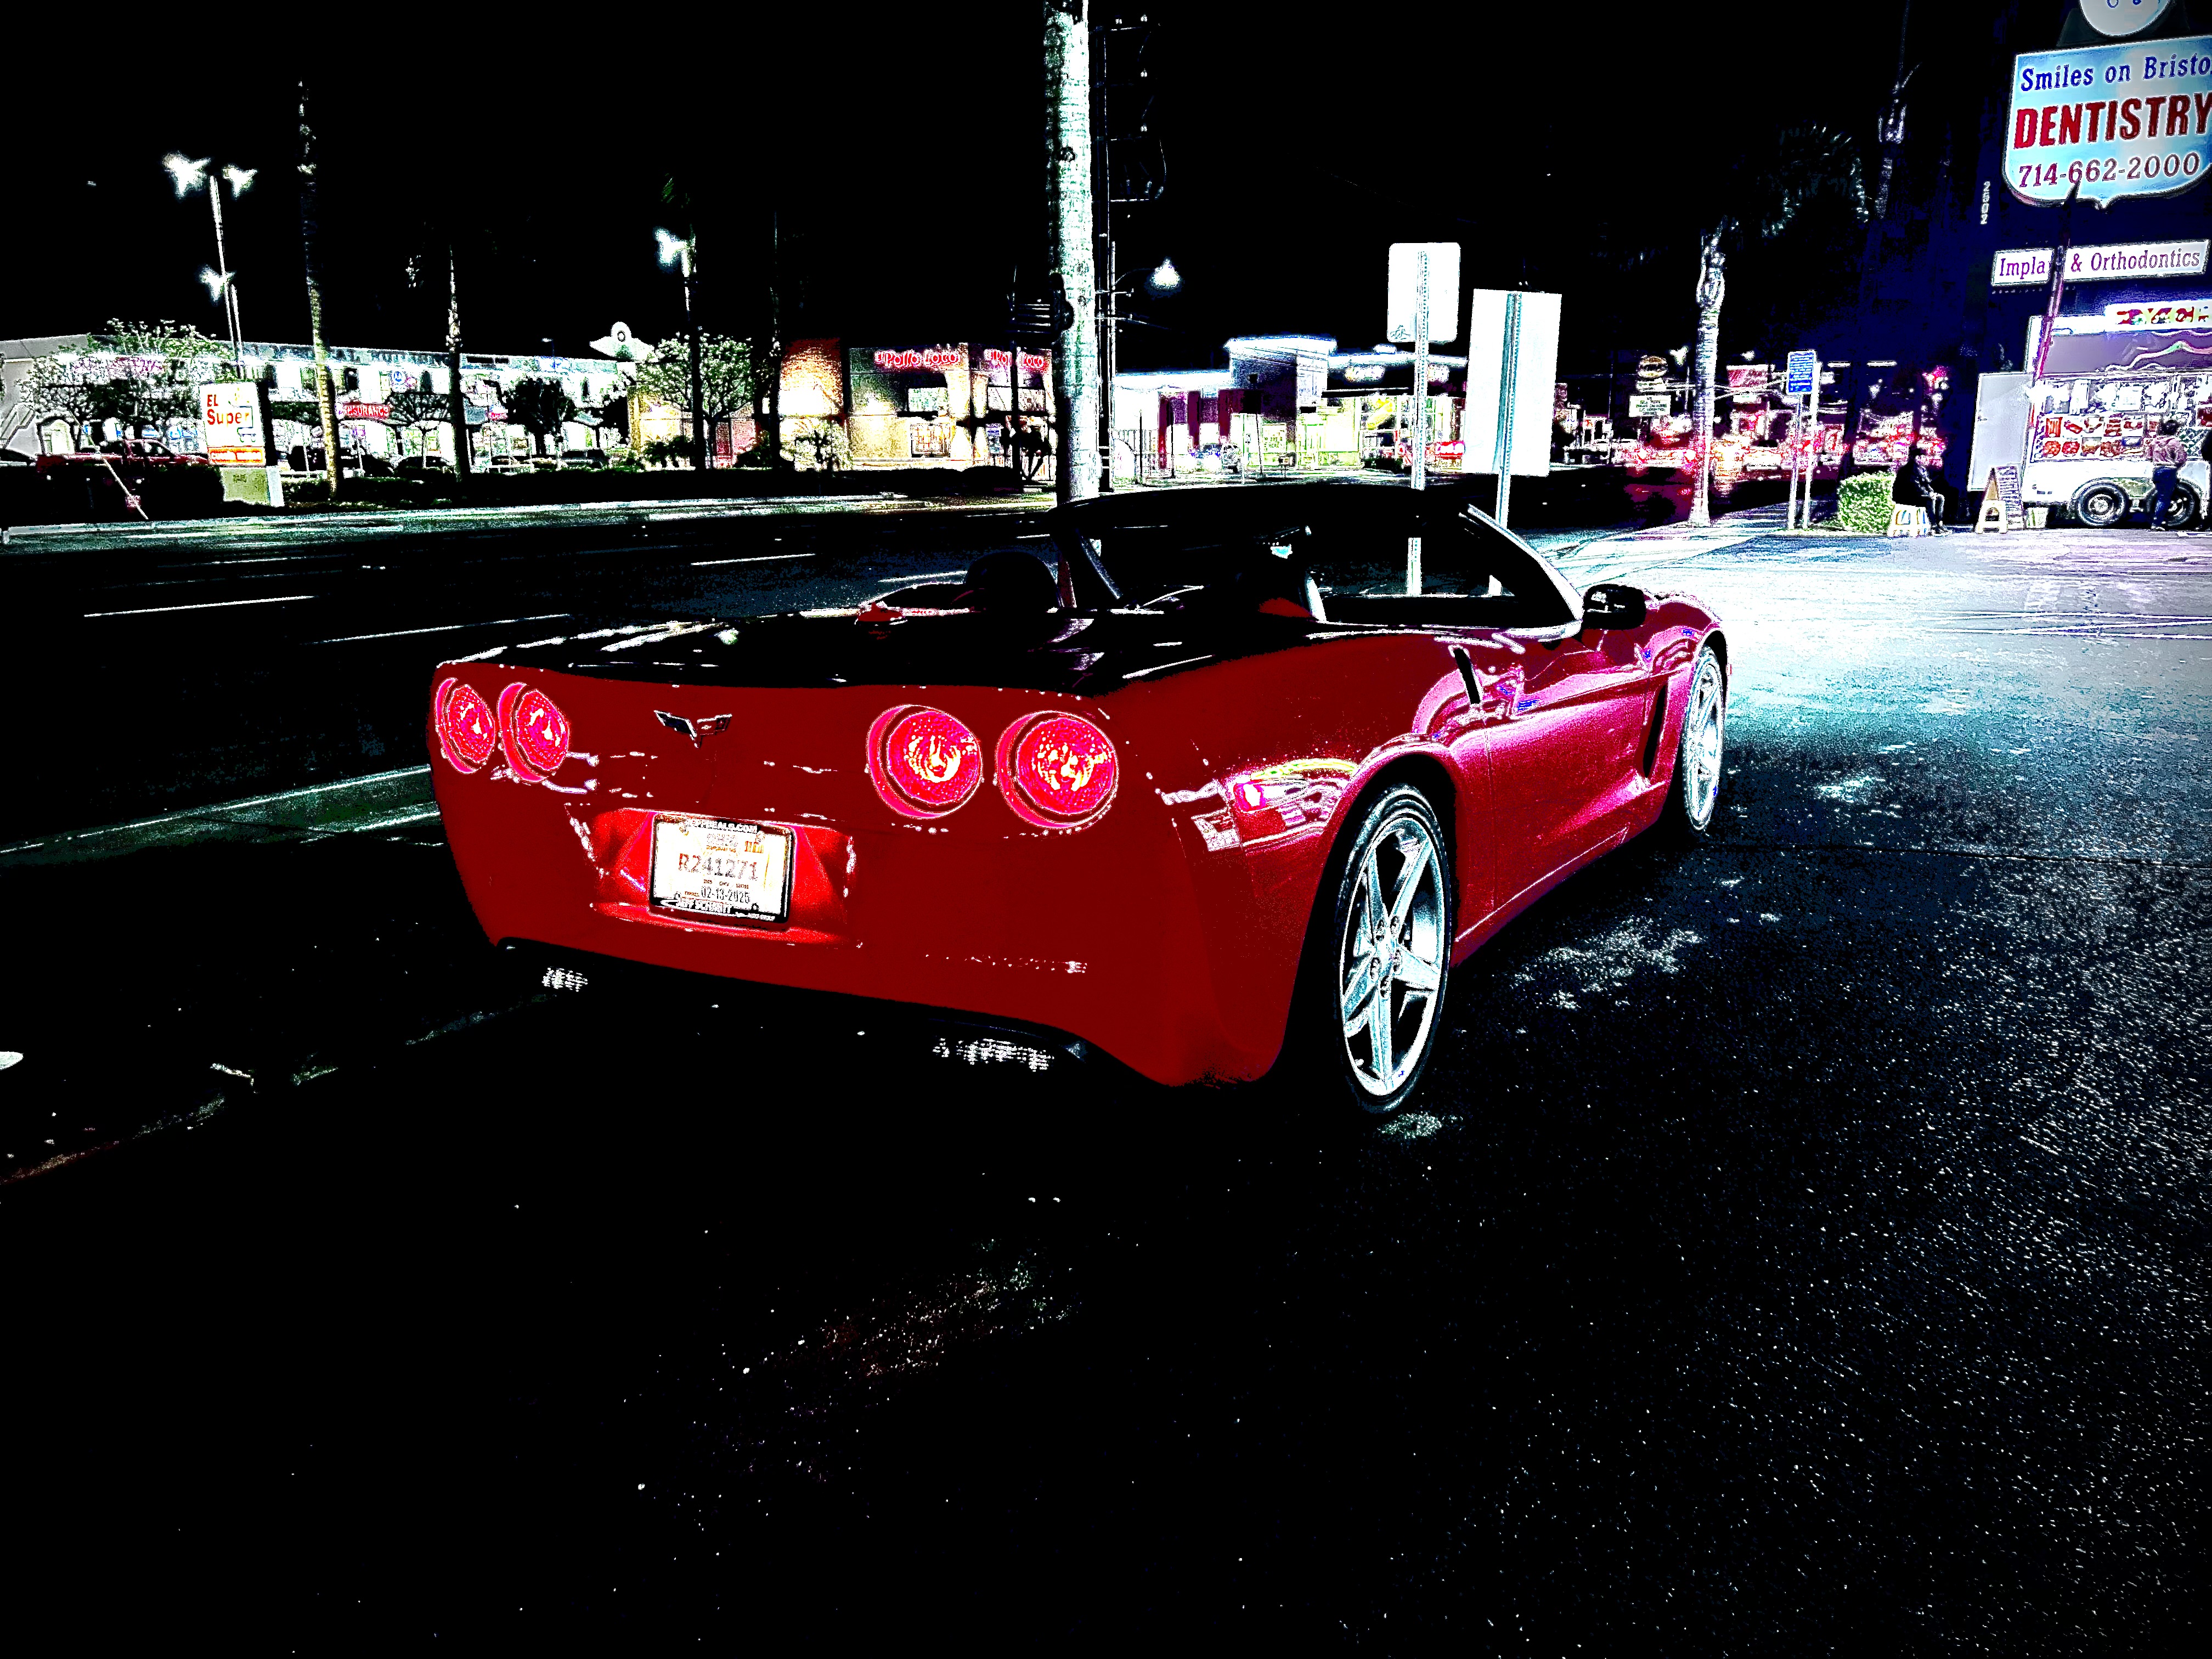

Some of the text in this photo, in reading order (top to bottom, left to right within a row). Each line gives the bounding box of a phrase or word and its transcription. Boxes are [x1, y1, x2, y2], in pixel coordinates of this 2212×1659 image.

[2021, 53, 2212, 92] Smiles on Bristo
[2013, 92, 2212, 150] DENTISTRY
[2018, 152, 2200, 188] 714-662-2000
[1980, 181, 1990, 224] 2502
[1999, 248, 2200, 280] Impla & Orthodontics
[884, 349, 923, 368] Pollo
[923, 349, 960, 366] Loco
[1019, 352, 1045, 369] Loco
[207, 394, 219, 407] EL
[207, 409, 250, 427] Super
[678, 853, 758, 881] R241271
[701, 885, 751, 904] 02-13-2025
